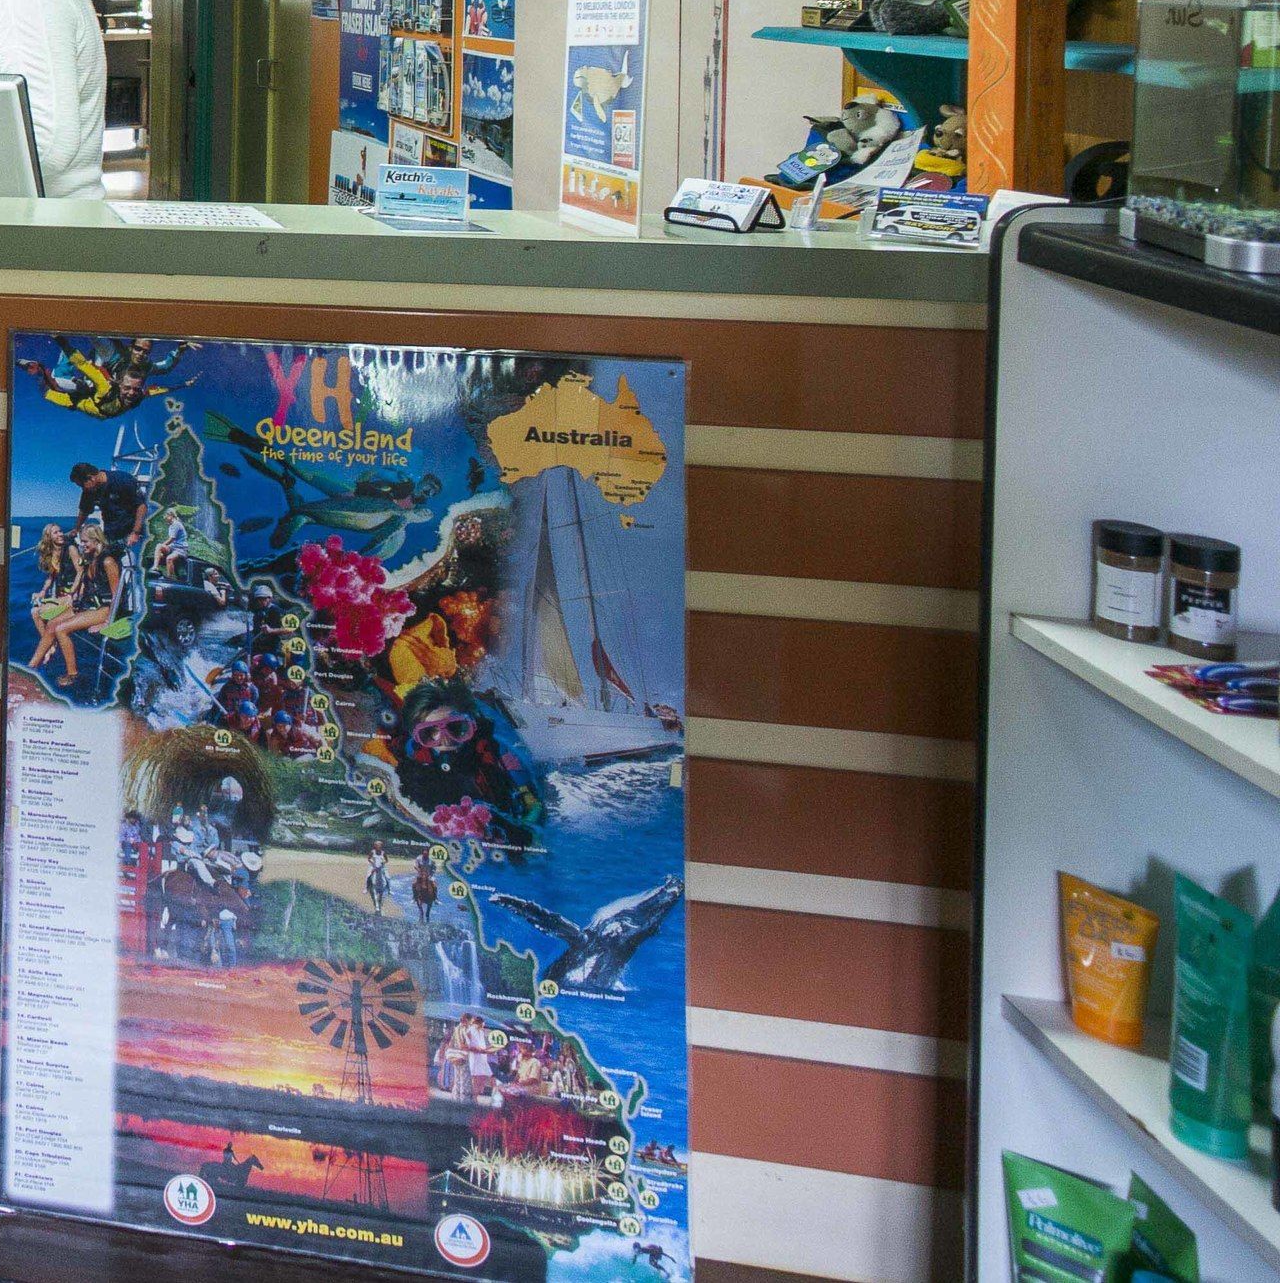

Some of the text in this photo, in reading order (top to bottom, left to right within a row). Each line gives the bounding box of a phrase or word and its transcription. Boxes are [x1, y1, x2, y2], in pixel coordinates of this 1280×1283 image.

[418, 184, 459, 197] Kayaks
[266, 352, 377, 430] YH
[256, 418, 414, 452] Queensland
[524, 426, 632, 448] Australia
[261, 446, 407, 467] the time of your life
[471, 884, 496, 892] Mackay
[178, 1199, 199, 1209] YHA
[246, 1213, 404, 1247] www.yha.com.au
[1028, 1211, 1104, 1257] Palmolive
